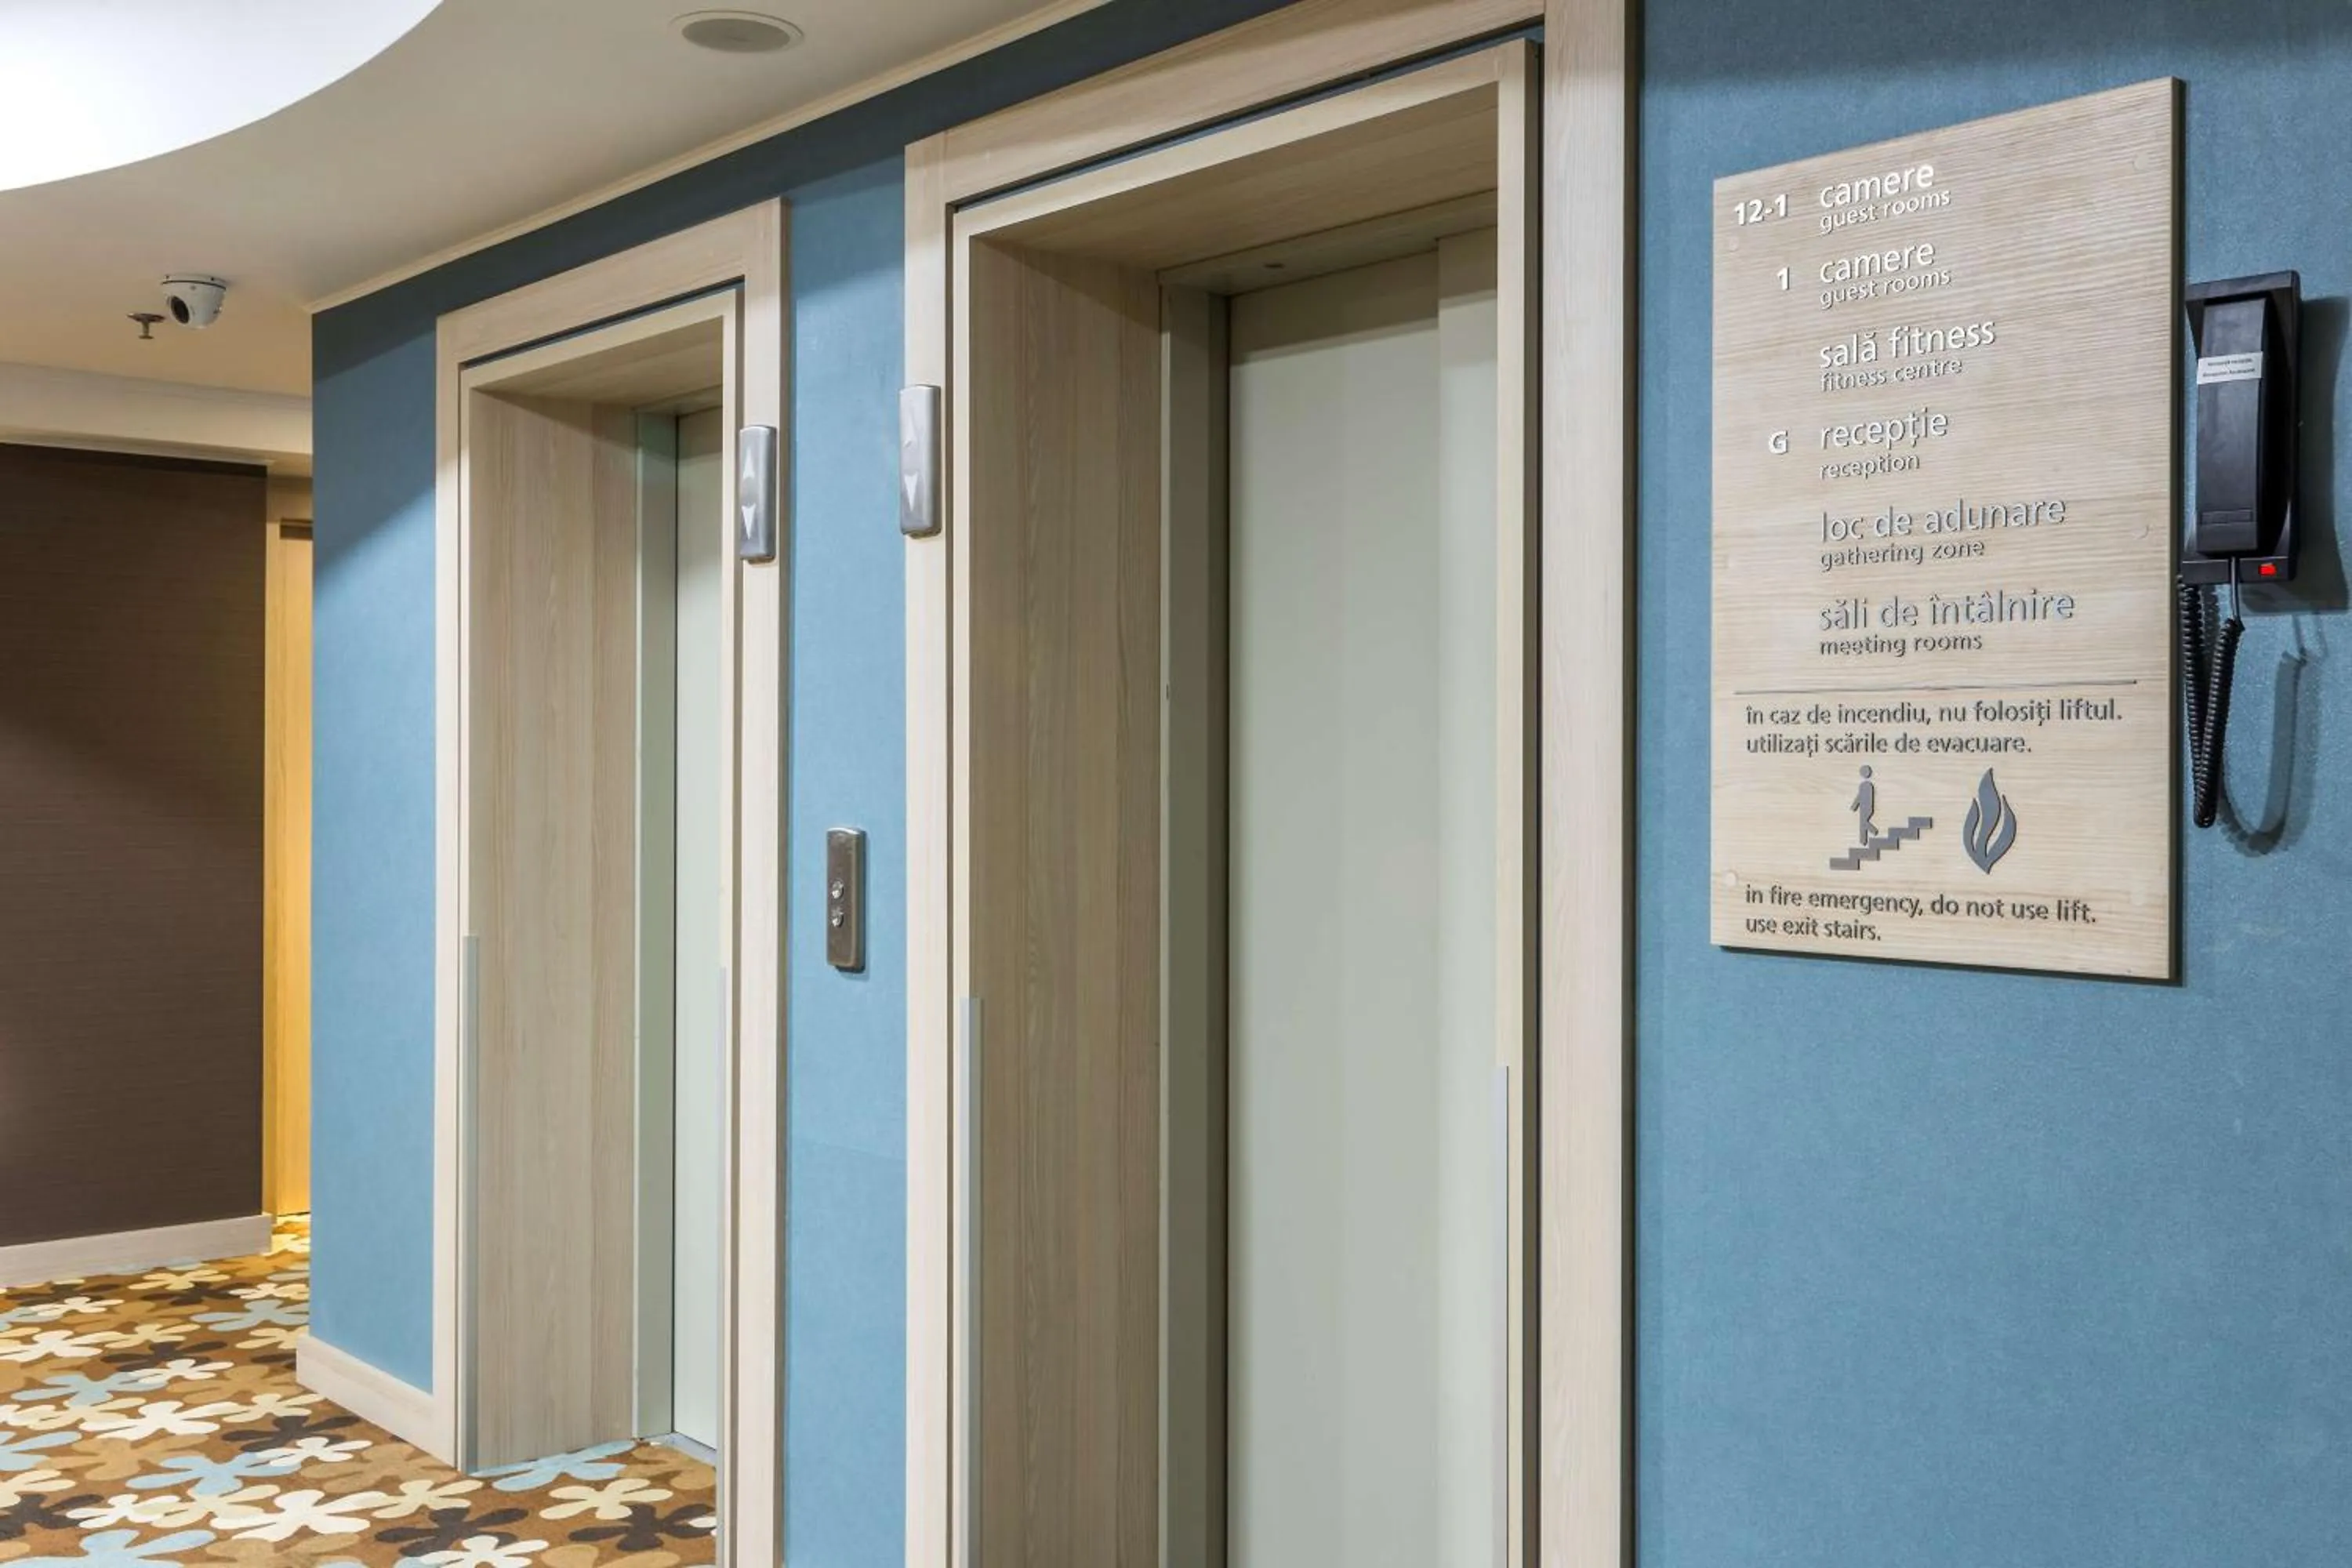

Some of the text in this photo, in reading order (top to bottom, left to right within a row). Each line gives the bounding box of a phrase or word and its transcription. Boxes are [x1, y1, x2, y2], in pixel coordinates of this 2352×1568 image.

[1820, 163, 1934, 208] camere
[1820, 190, 1951, 235] guest rooms
[1777, 267, 1790, 290] 1
[1820, 242, 1934, 284] camere
[1820, 269, 1951, 310] guest rooms
[1820, 320, 1995, 368] sală fitness
[1820, 358, 1962, 392] fitness centre
[1769, 430, 1788, 454] G
[1820, 454, 1920, 479] reception
[1822, 498, 2066, 542] loc de adunare
[1820, 540, 1984, 572] gathering zone
[1820, 590, 2074, 630] săli de întâlnire
[1820, 633, 1982, 657] meeting rooms
[1747, 706, 1763, 724] în
[1769, 709, 1800, 724] caz
[1806, 704, 1831, 724] de
[1838, 702, 1930, 726] incendiu,
[1939, 705, 1966, 722] nu
[2060, 699, 2122, 721] liftul.
[1824, 733, 1886, 753] scările
[1894, 735, 1921, 753] de
[1927, 736, 2031, 753] evacuare.
[1745, 884, 2096, 924] in fire emergency, do not use lift.
[1746, 916, 1881, 942] use exit stairs.
